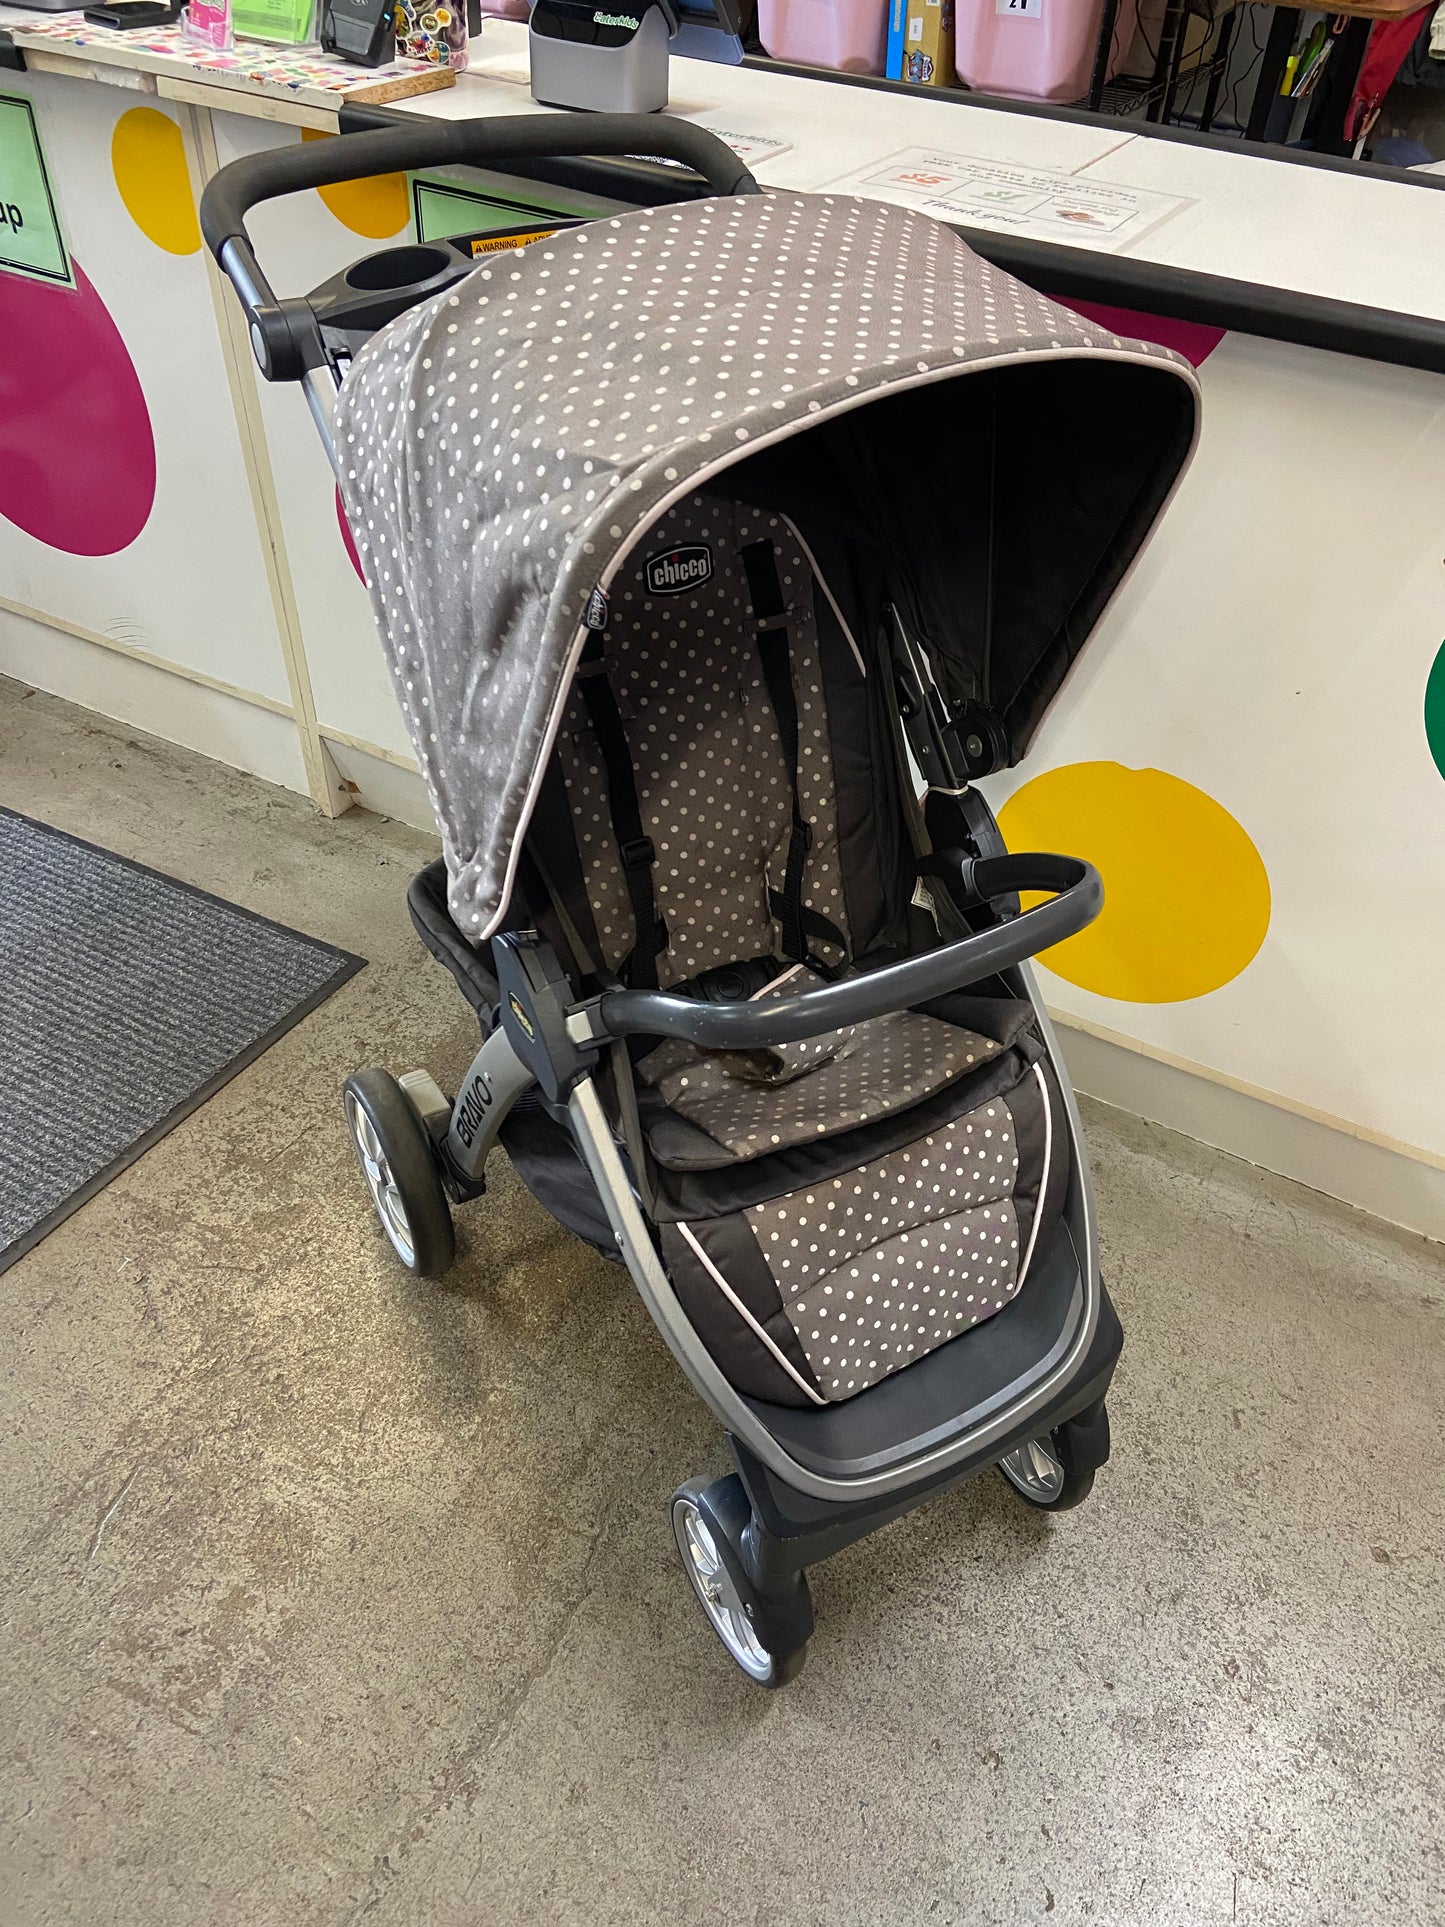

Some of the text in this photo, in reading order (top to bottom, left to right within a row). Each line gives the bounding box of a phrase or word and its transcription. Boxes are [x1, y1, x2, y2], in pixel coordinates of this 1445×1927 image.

[893, 173, 952, 185] $5
[922, 199, 984, 216] Thank
[482, 239, 518, 252] WARNING
[654, 554, 707, 586] chicco
[457, 1075, 492, 1149] BRAVO
